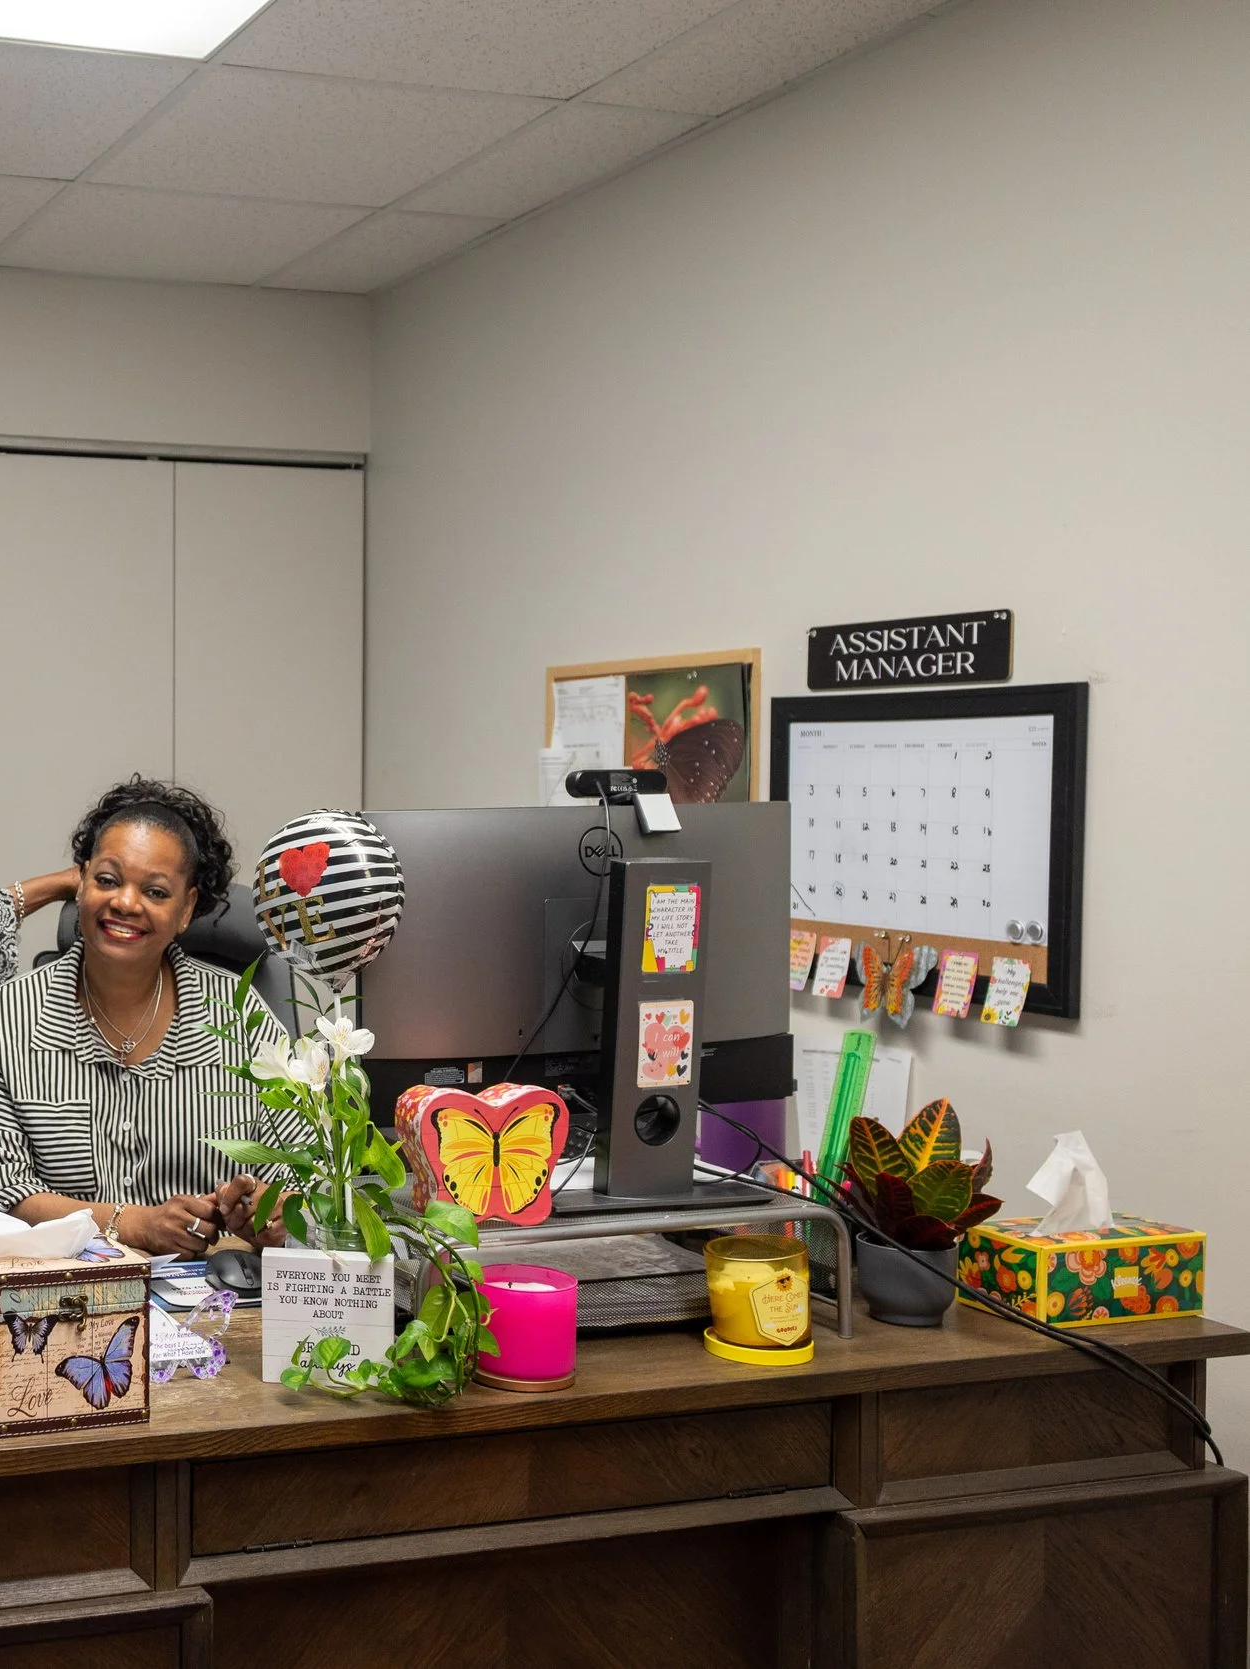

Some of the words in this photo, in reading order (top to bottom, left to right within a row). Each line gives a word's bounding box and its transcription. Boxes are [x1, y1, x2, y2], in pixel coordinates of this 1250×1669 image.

[829, 620, 987, 656] ASSISTANT
[836, 651, 975, 682] MANAGER
[809, 784, 815, 796] 3
[836, 785, 841, 798] 4
[862, 786, 867, 797] 5
[920, 787, 926, 797] 7
[951, 787, 957, 798] 8
[985, 788, 991, 798] 9
[862, 822, 870, 831] 12
[890, 822, 897, 832] 13
[920, 823, 927, 835] 14
[952, 825, 959, 835] 15
[584, 845, 619, 858] DELL
[835, 853, 841, 863] 18
[862, 853, 868, 863] 19
[890, 857, 898, 866] 20
[920, 860, 927, 869] 21
[950, 861, 959, 871] 22
[982, 864, 990, 873] 23
[835, 886, 843, 897] 25
[889, 892, 897, 903] 27
[1006, 968, 1016, 977] My
[995, 987, 1008, 996] help
[654, 1032, 658, 1042] I
[663, 1033, 680, 1042] can
[662, 1047, 679, 1059] will
[276, 1270, 326, 1281] EVERYONE
[331, 1273, 350, 1283] YOU
[356, 1274, 382, 1284] MEET
[267, 1282, 279, 1291] IS
[285, 1283, 334, 1294] FIGHTING
[340, 1287, 347, 1295] A
[353, 1287, 392, 1297] BATTLE
[279, 1295, 298, 1304] YOU
[303, 1296, 328, 1306] KNOW
[334, 1298, 378, 1309] NOTHING
[312, 1310, 344, 1320] ABOUT
[7, 1376, 53, 1418] Love
